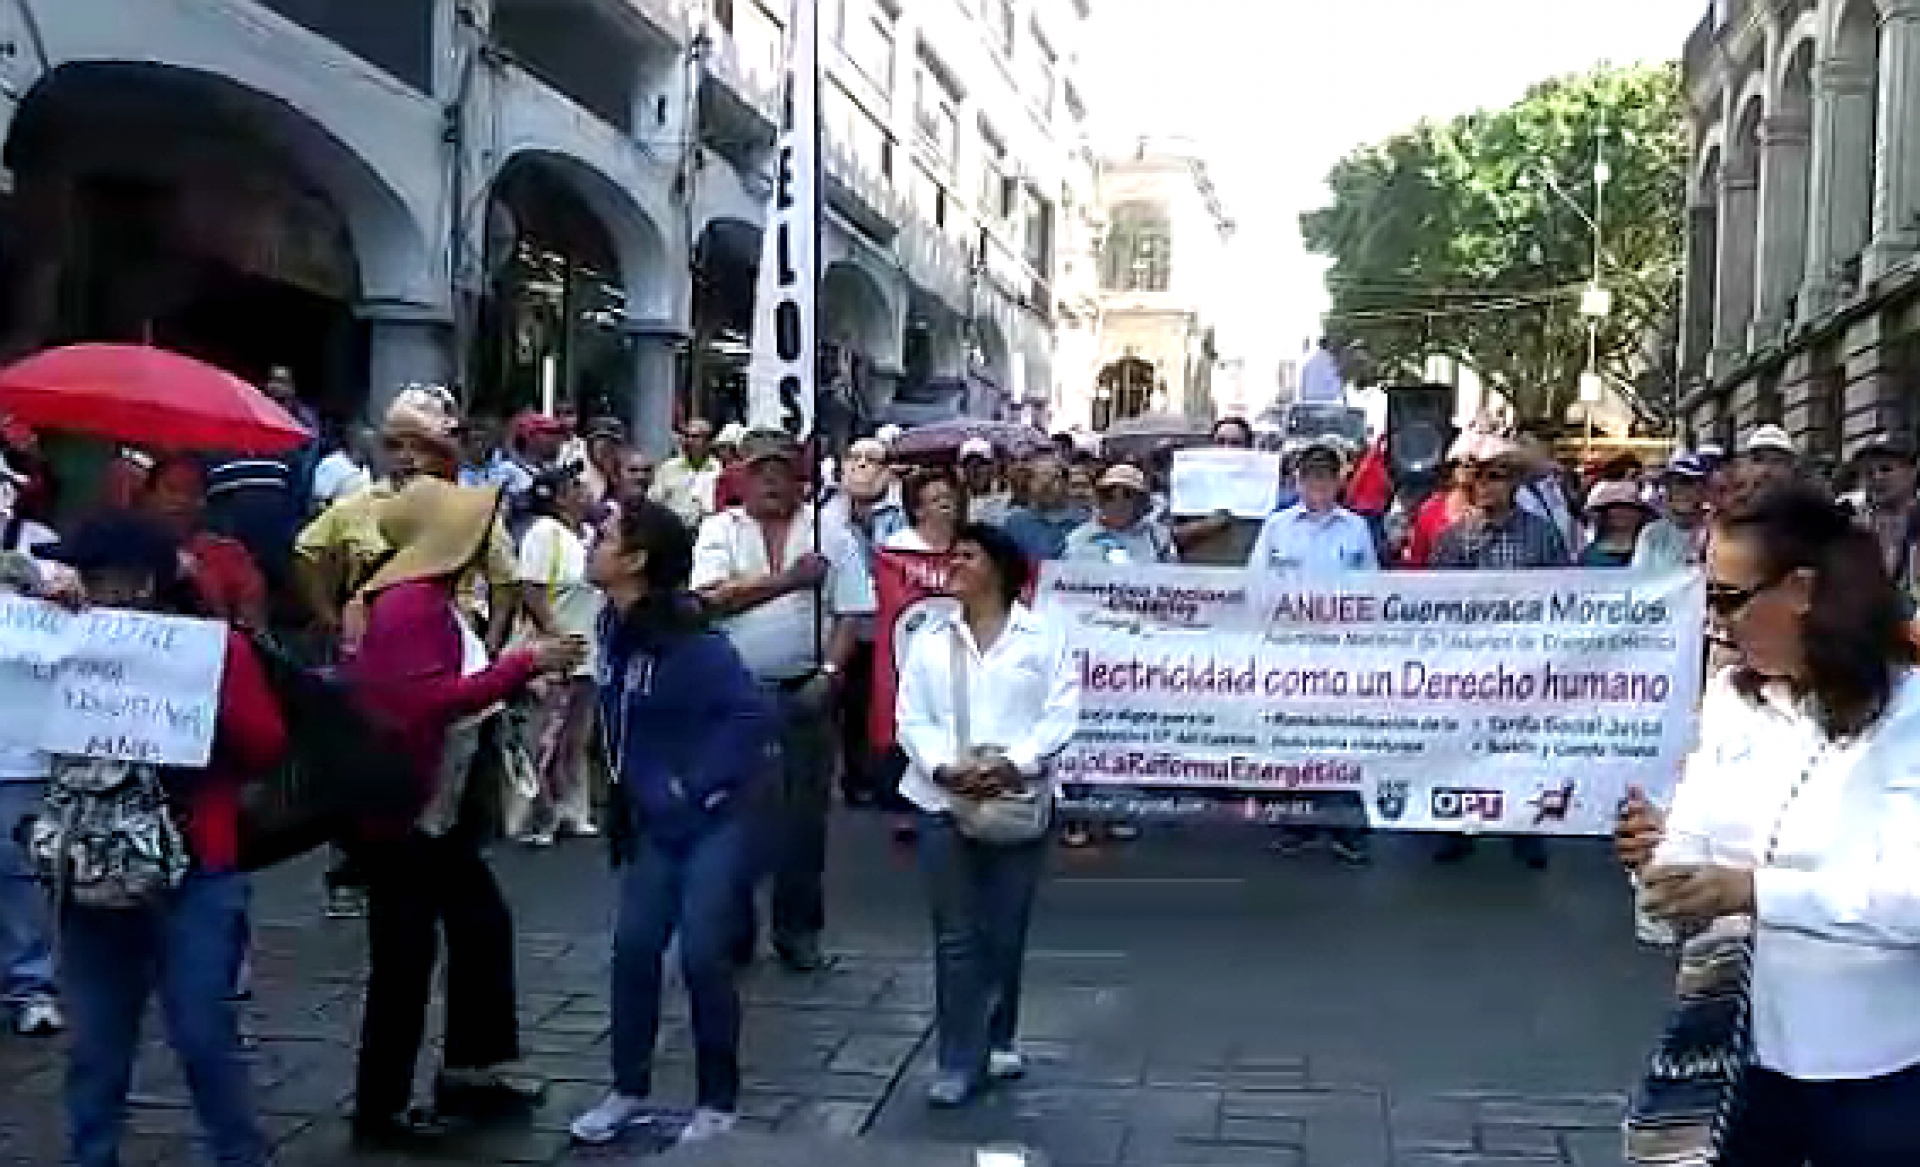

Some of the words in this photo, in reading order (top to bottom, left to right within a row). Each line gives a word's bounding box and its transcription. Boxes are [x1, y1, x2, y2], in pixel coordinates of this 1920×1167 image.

[1271, 593, 1377, 622] ANUEE
[1382, 593, 1543, 624] Cuernavaca
[1549, 590, 1667, 624] Morelos
[1072, 648, 1257, 693] lectricidad
[1263, 665, 1349, 698] como
[1355, 668, 1393, 698] un
[1400, 660, 1535, 701] Derecho
[1542, 661, 1669, 703] humano
